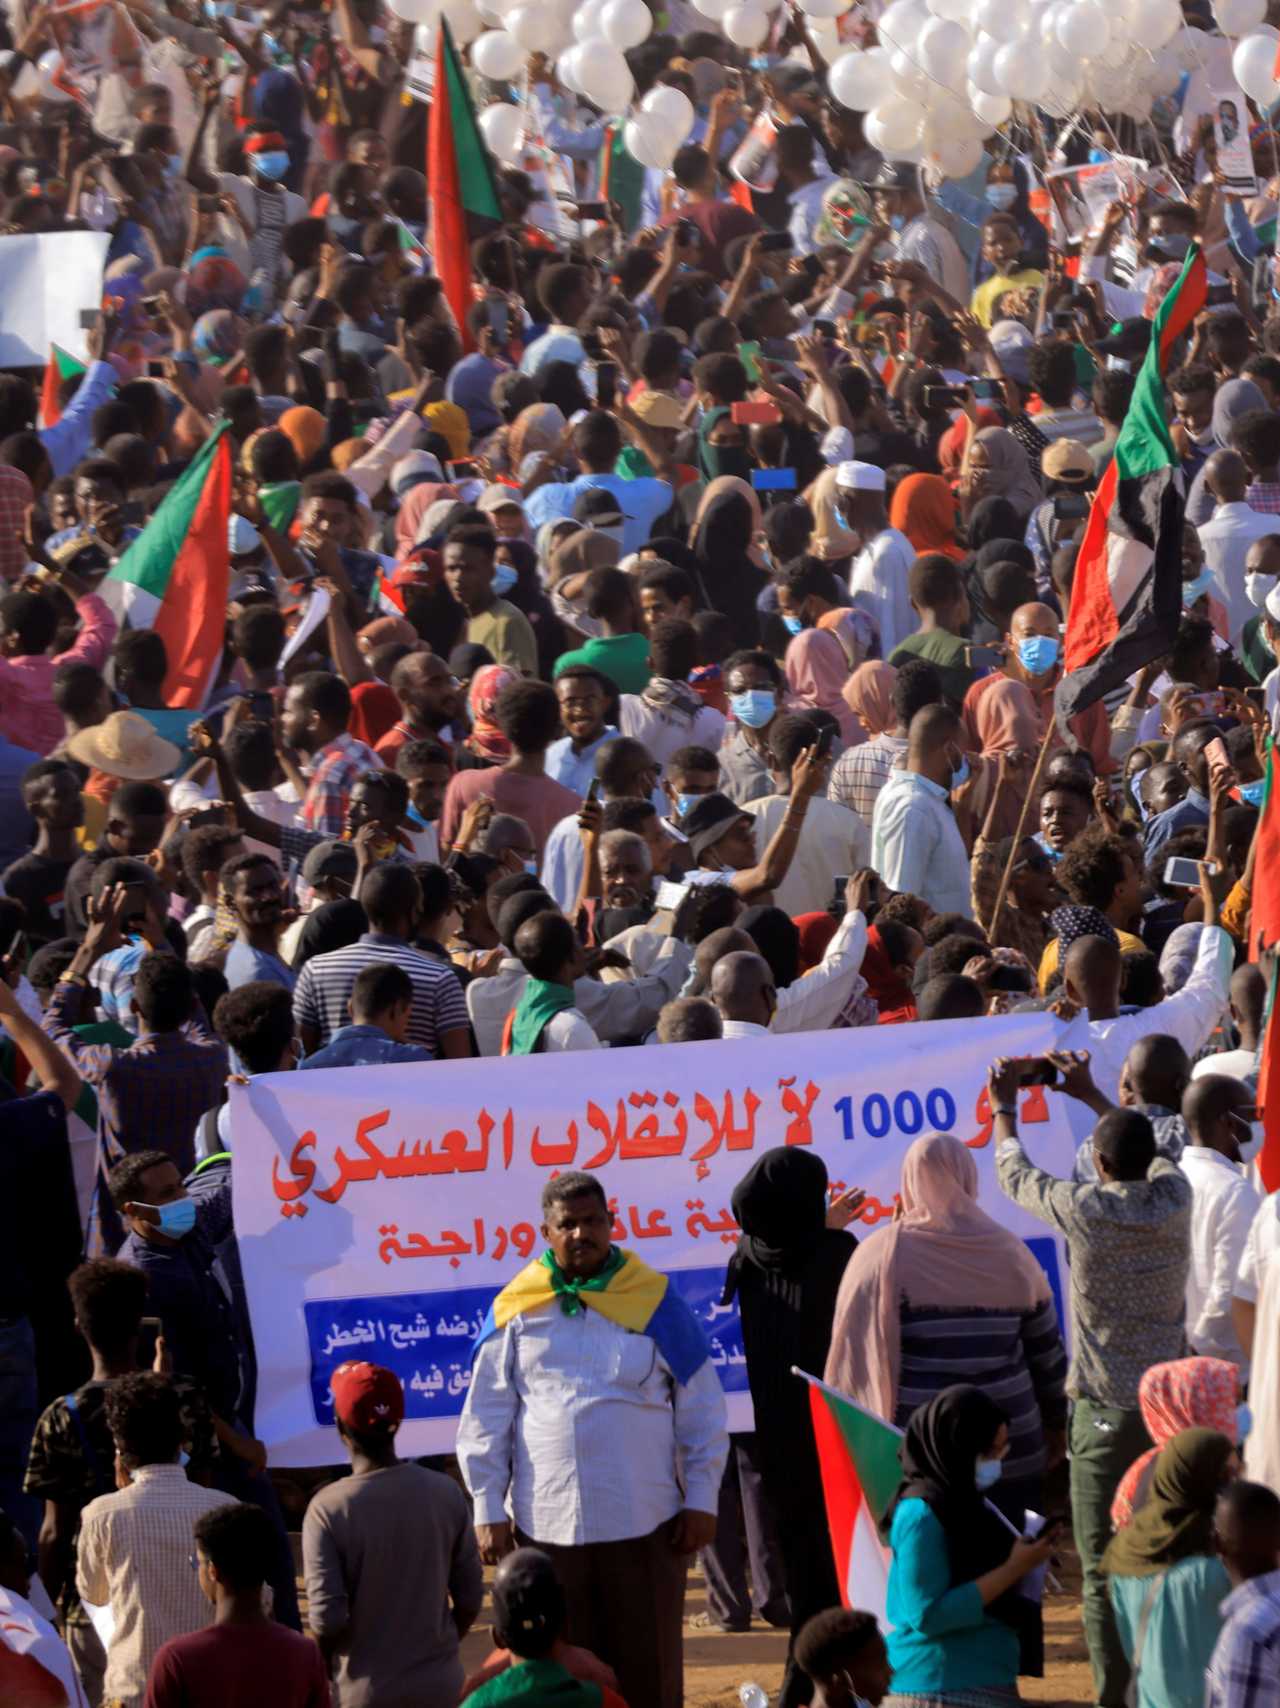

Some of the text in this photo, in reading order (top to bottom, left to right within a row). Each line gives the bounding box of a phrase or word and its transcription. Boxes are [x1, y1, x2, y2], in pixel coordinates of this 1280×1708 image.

[833, 1086, 957, 1141] 1000
[271, 1106, 515, 1219] العسكري
[377, 1217, 536, 1269] وراجحة
[323, 1320, 385, 1355] الخطر
[389, 1313, 430, 1348] شبح
[410, 1364, 444, 1398] فيه
